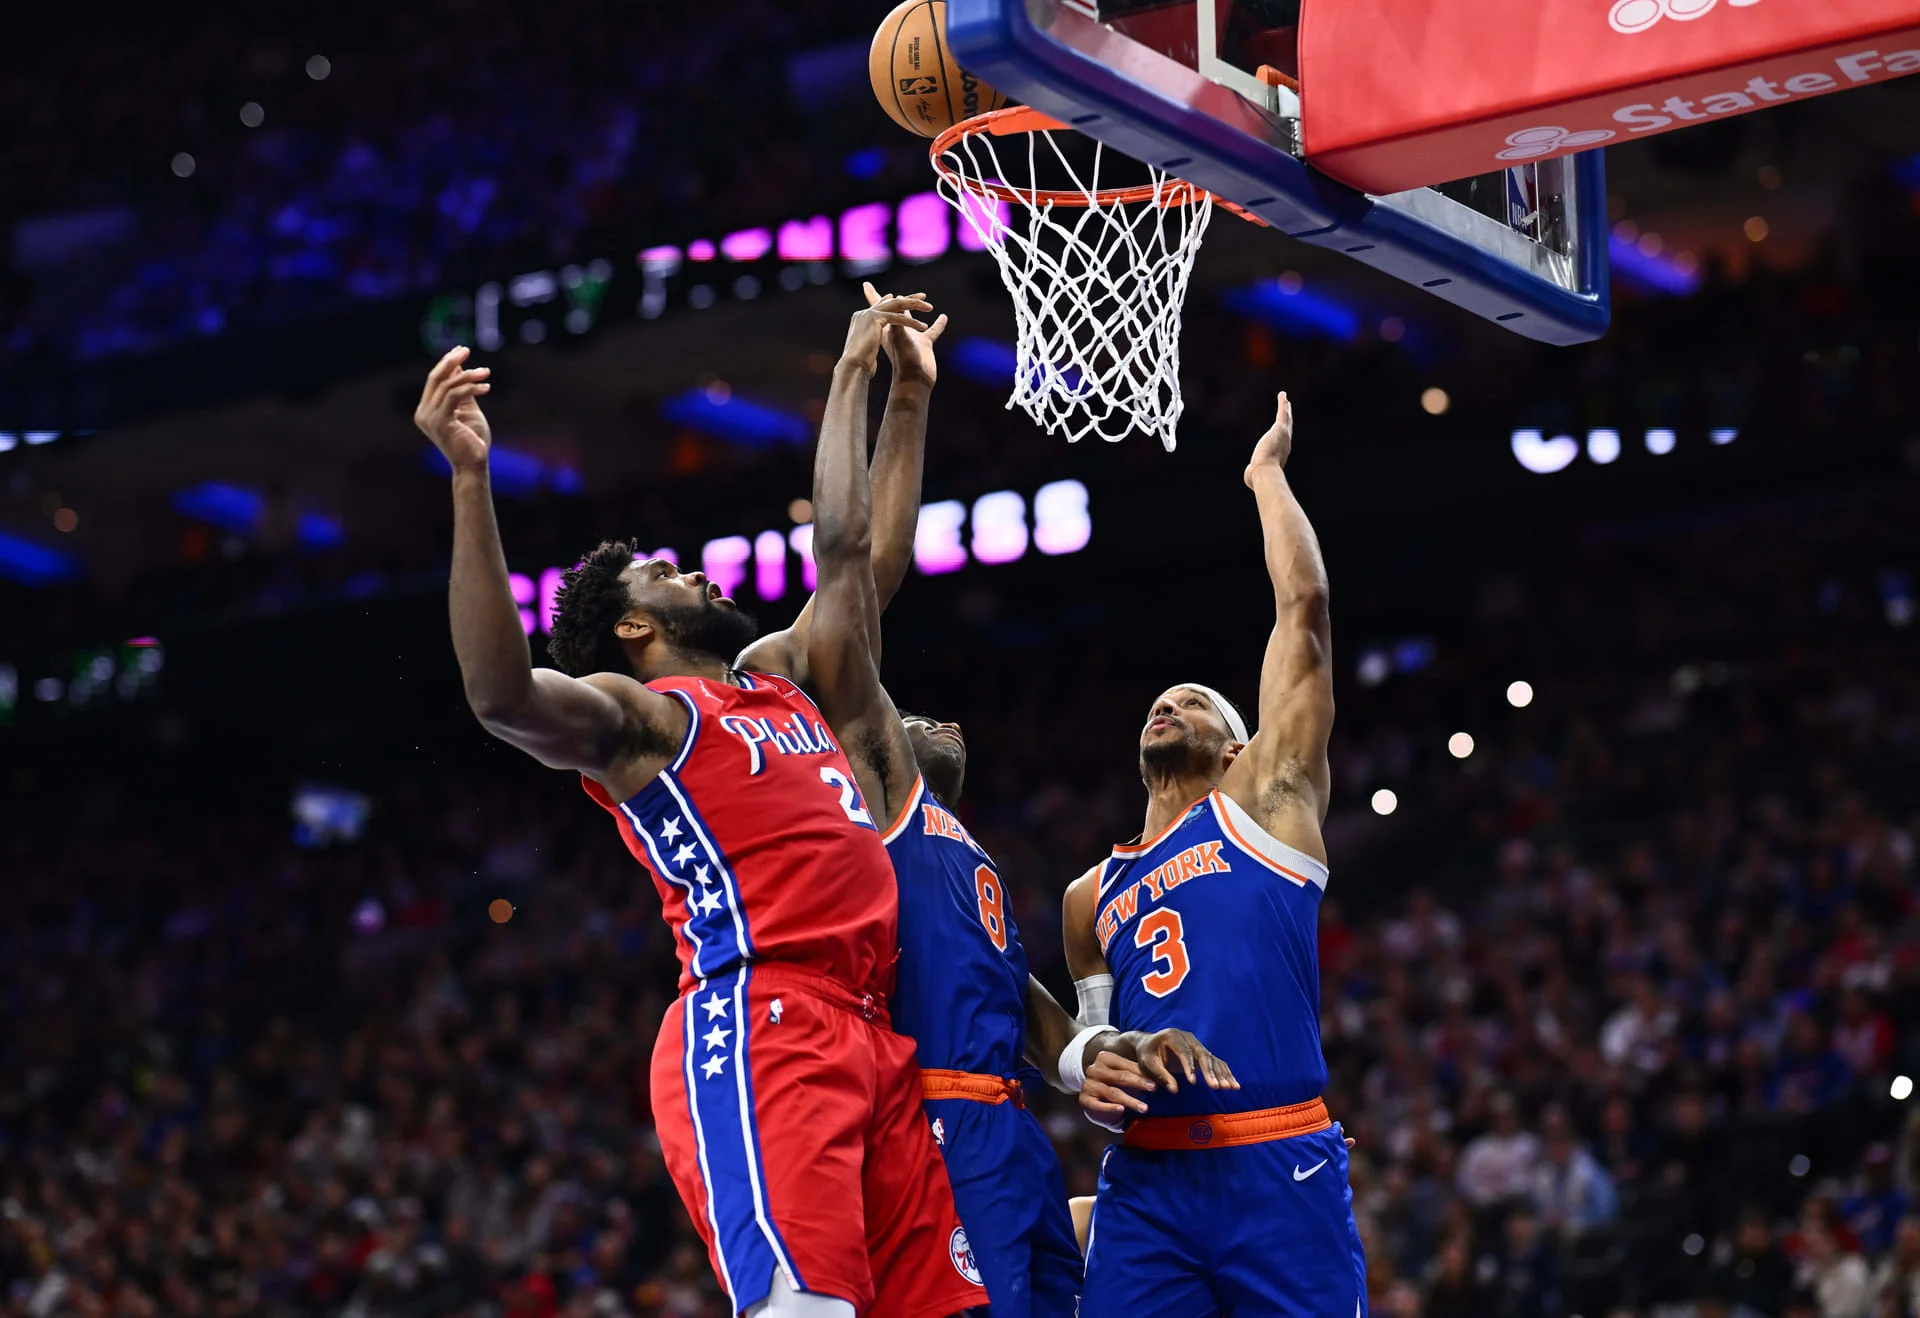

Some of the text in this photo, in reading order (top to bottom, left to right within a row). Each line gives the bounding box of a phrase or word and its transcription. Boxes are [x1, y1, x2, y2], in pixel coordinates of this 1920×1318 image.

[1612, 76, 1837, 132] State
[702, 478, 1092, 602] FIESS
[719, 713, 839, 776] Phila
[819, 766, 878, 832] 2
[974, 862, 1008, 953] 8
[1095, 839, 1232, 951] NEW YORK
[1134, 906, 1190, 999] 3
